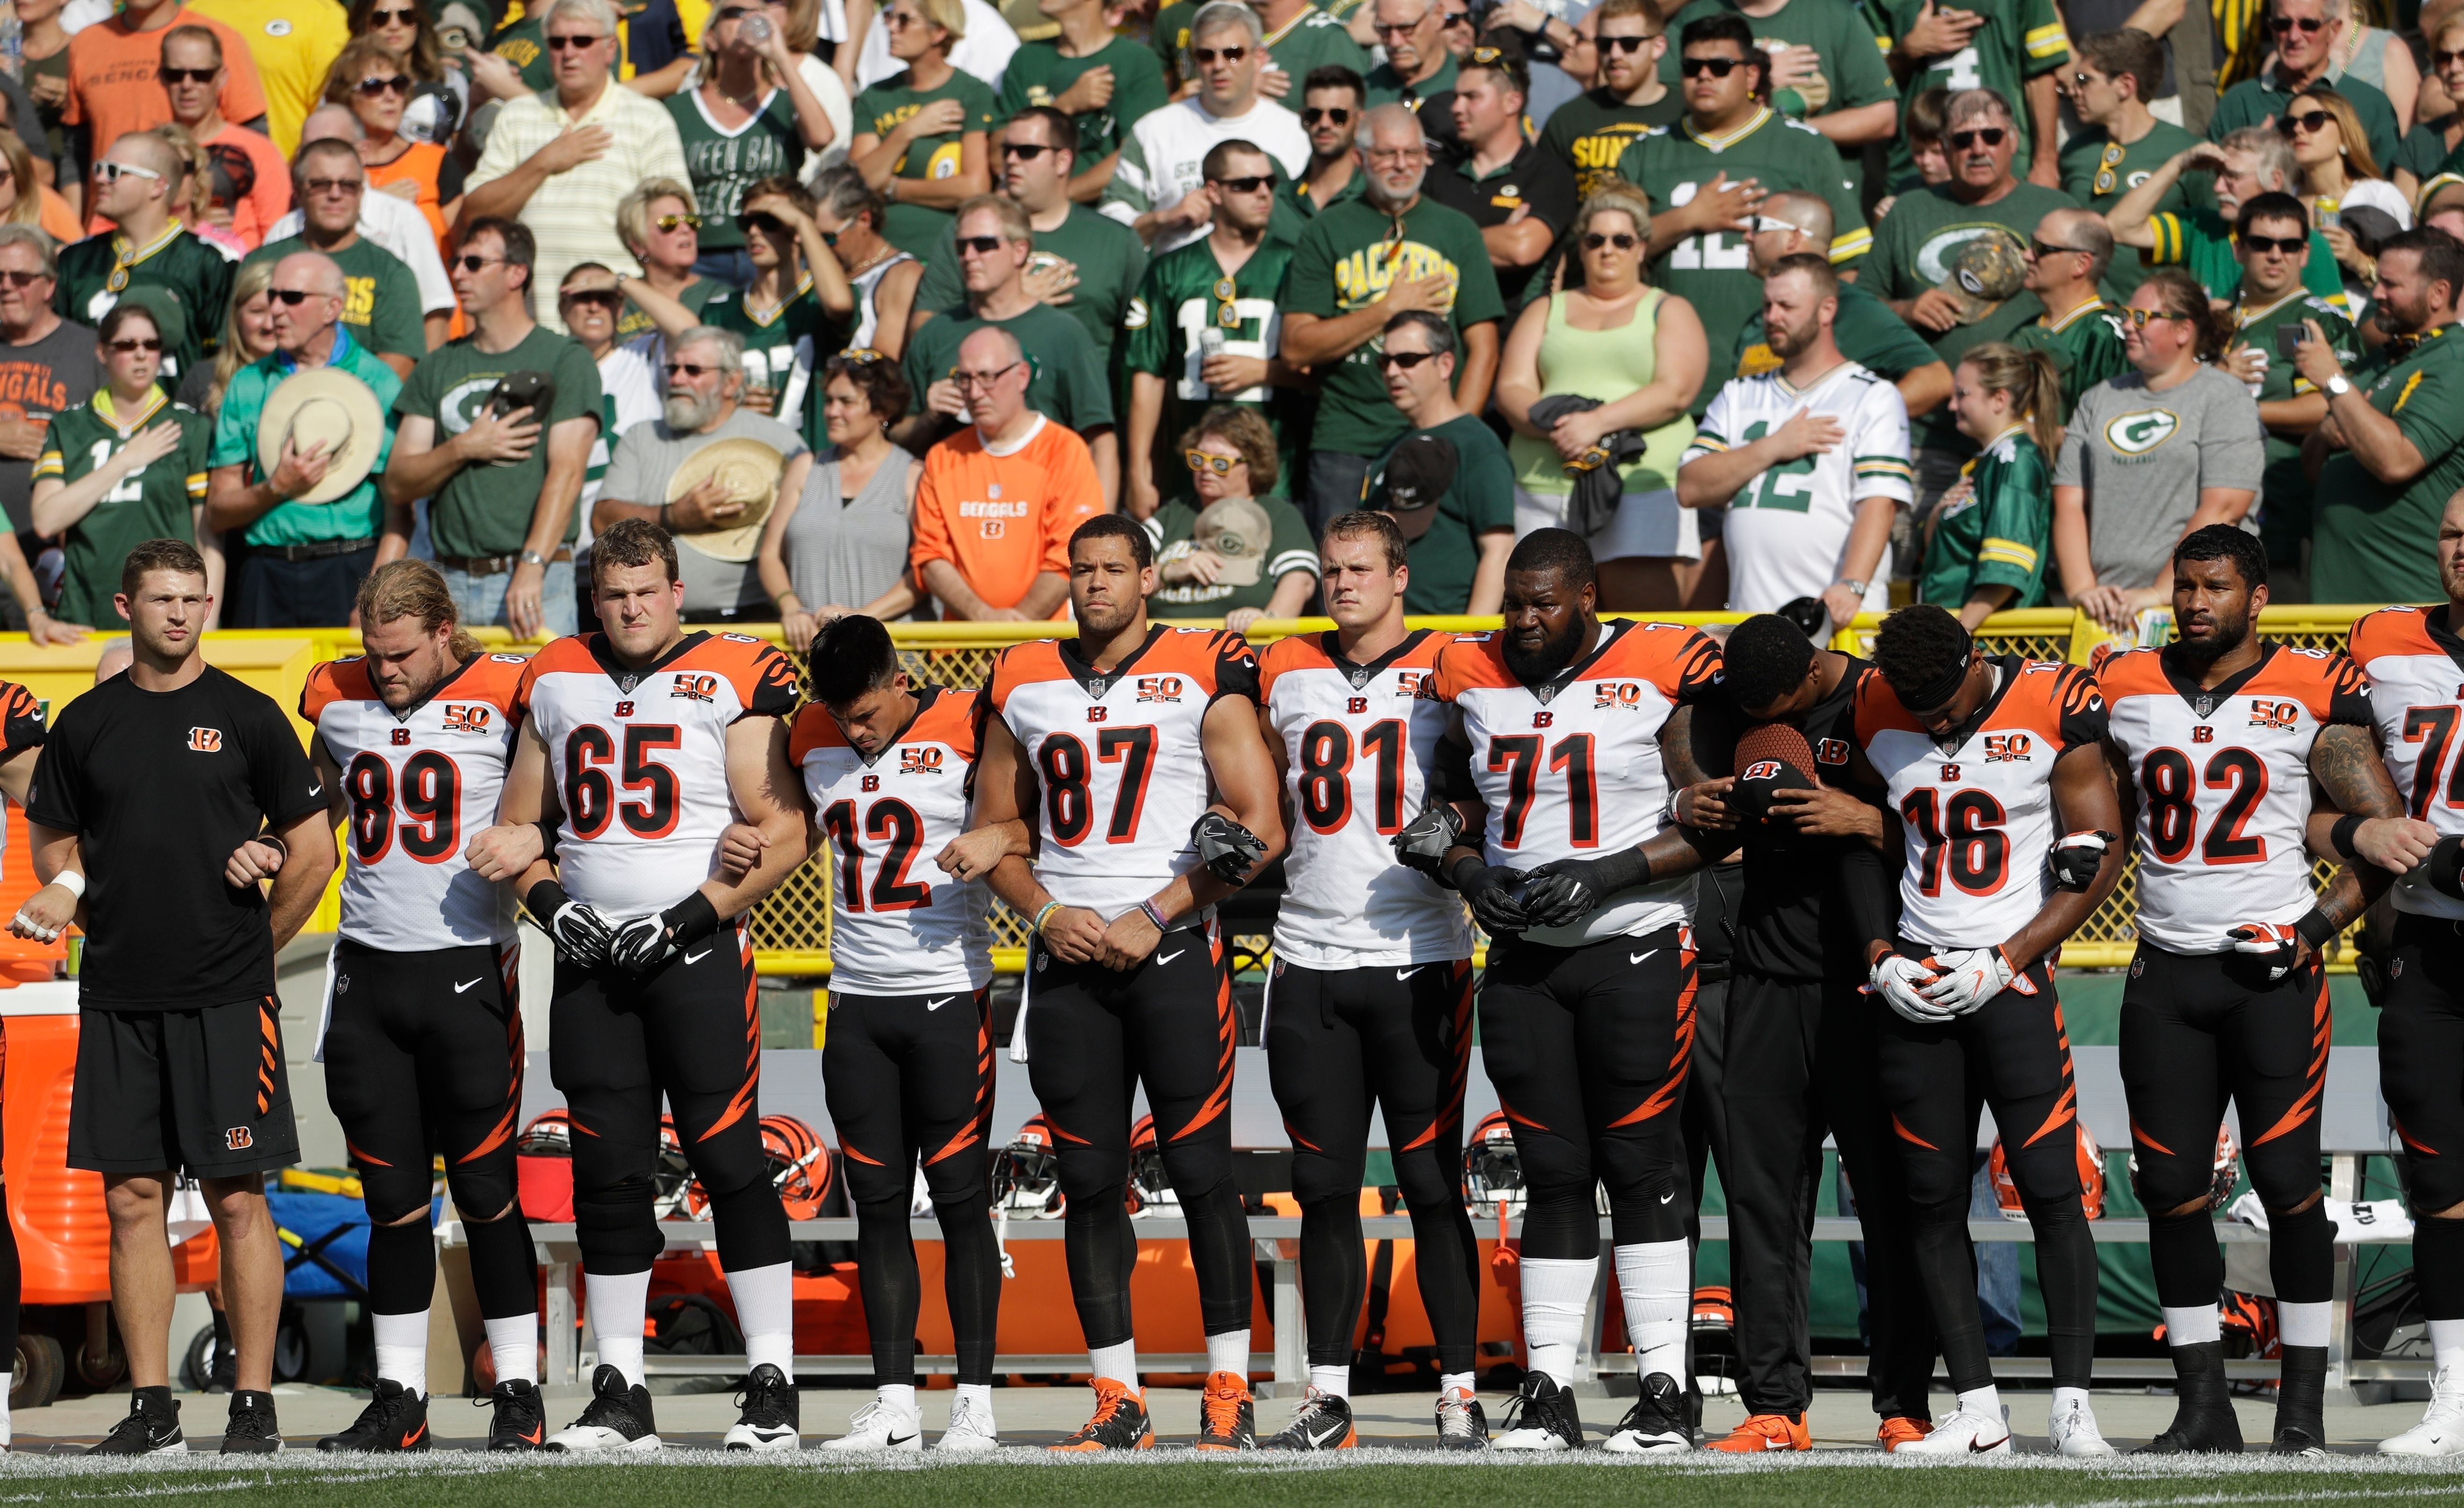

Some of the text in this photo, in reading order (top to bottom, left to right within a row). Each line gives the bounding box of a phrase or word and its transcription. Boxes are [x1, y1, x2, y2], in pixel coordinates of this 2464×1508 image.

[959, 502, 1027, 518] BENGALS
[444, 705, 490, 727] 50
[673, 675, 717, 695] 50
[1137, 677, 1183, 697] 50
[1595, 683, 1641, 704] 50
[2250, 700, 2298, 724] 50
[901, 747, 943, 768] 50
[1300, 719, 1406, 835] 81
[1983, 734, 2032, 757] 50
[345, 750, 461, 866] 89
[565, 724, 681, 840] 65
[1039, 725, 1158, 847] 87
[1488, 732, 1599, 849] 71
[2140, 747, 2269, 865] 82
[823, 797, 932, 913] 12
[1901, 787, 2010, 898] 16
